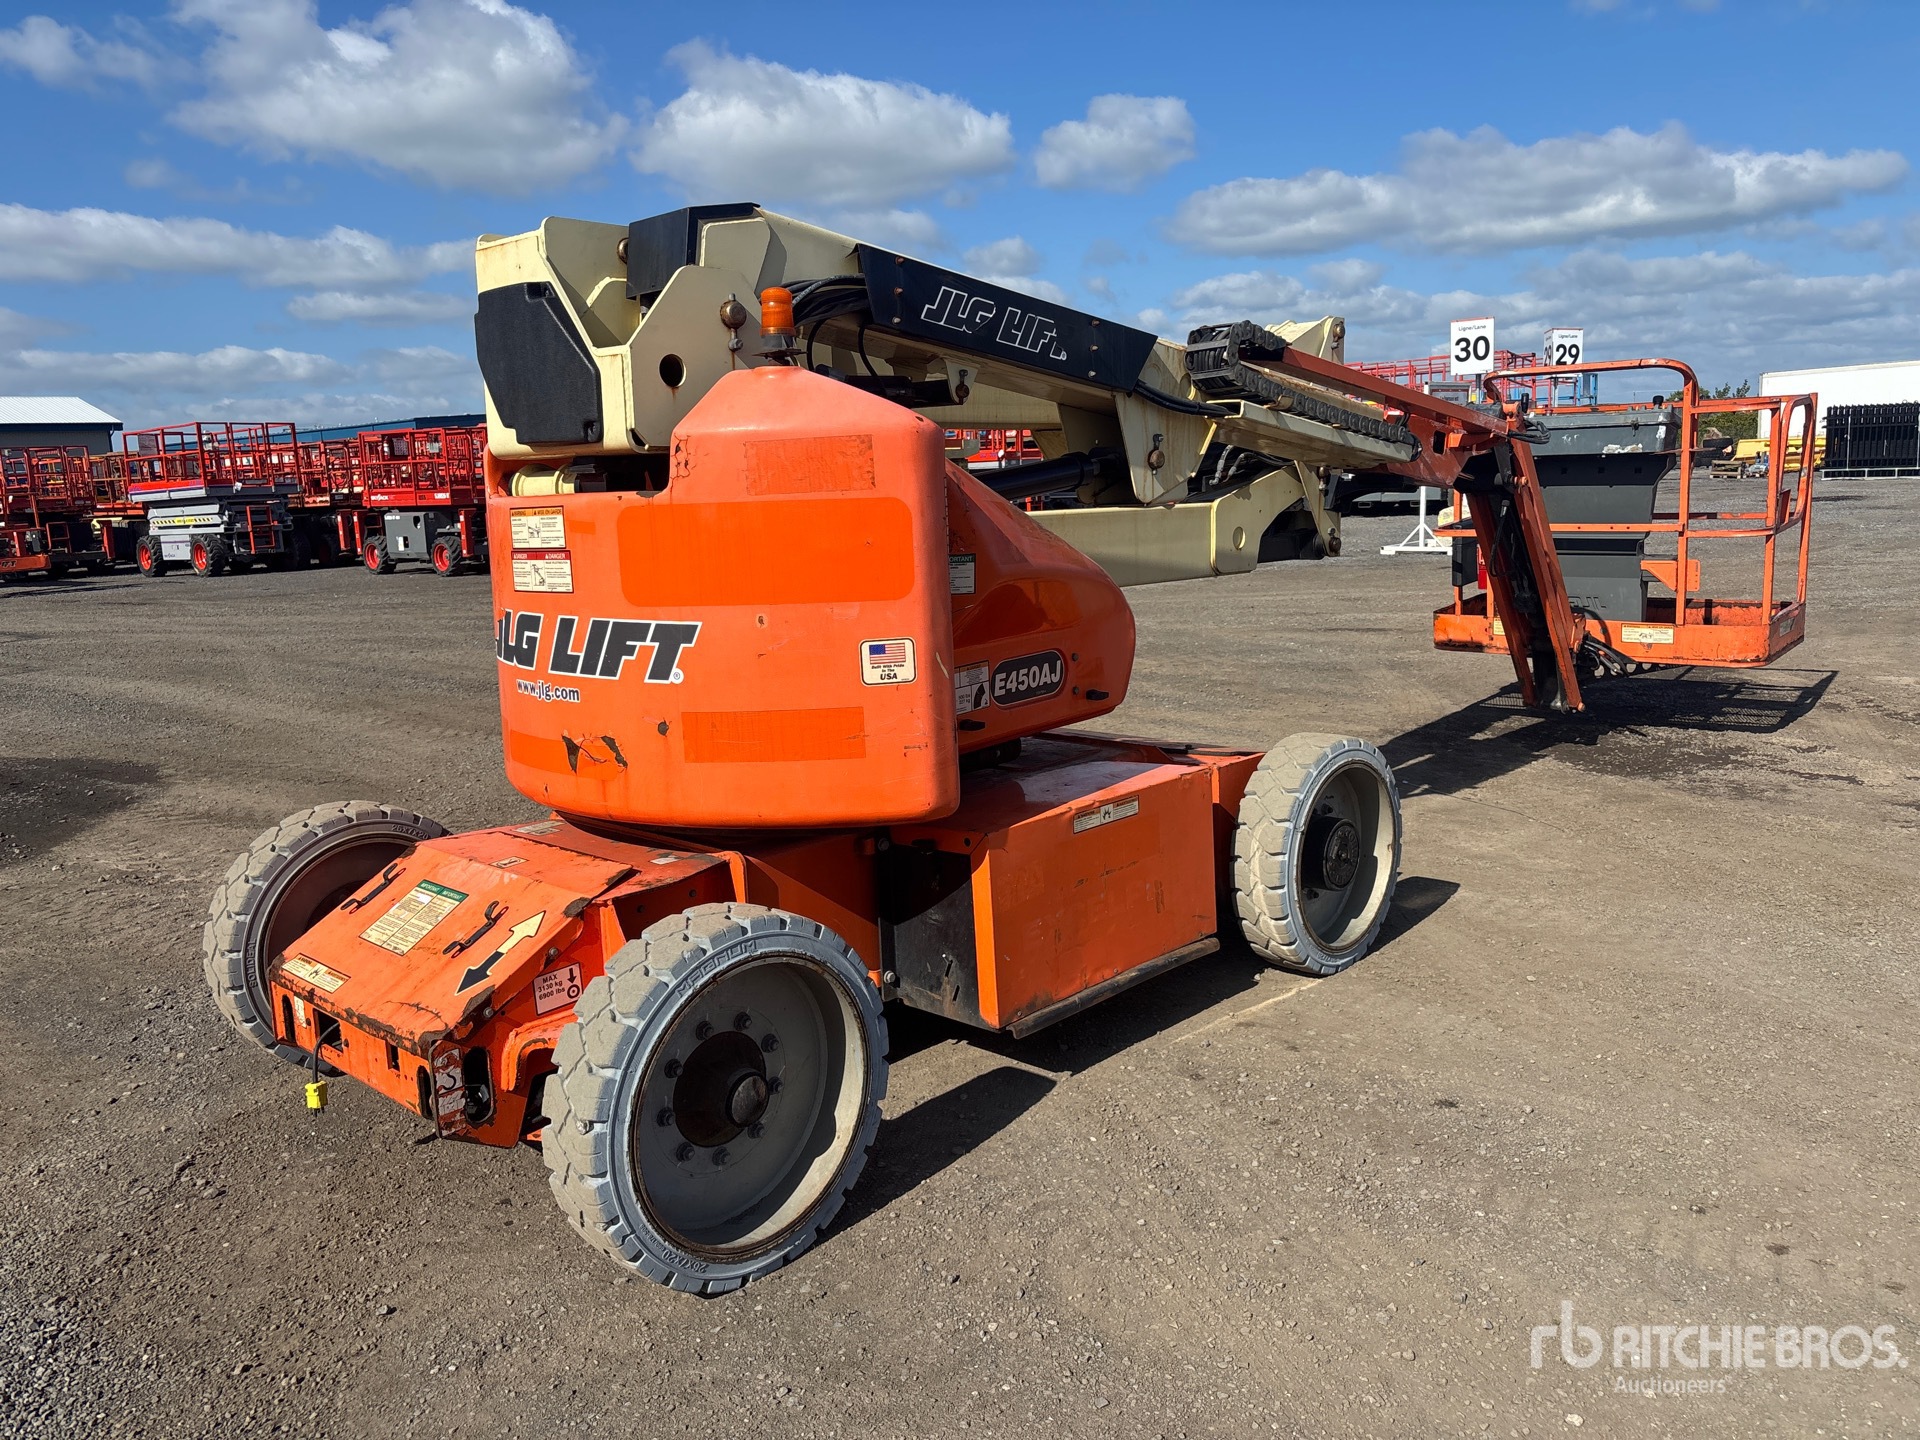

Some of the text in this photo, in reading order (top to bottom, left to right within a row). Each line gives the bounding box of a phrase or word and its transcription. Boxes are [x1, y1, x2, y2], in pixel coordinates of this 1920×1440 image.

[921, 286, 996, 334] JLG
[1454, 335, 1490, 362] 30
[1555, 343, 1580, 365] 29
[949, 555, 973, 563] ORTANT
[548, 614, 702, 683] LIFT
[880, 672, 898, 680] USA
[994, 660, 1060, 697] E450AJ
[516, 679, 581, 703] www.jlg.com
[246, 938, 258, 988] SOLIDEAL
[676, 940, 757, 998] MAGNUM
[538, 982, 553, 993] 3130
[542, 973, 558, 984] MAX
[538, 987, 566, 1001] 6900 lbs
